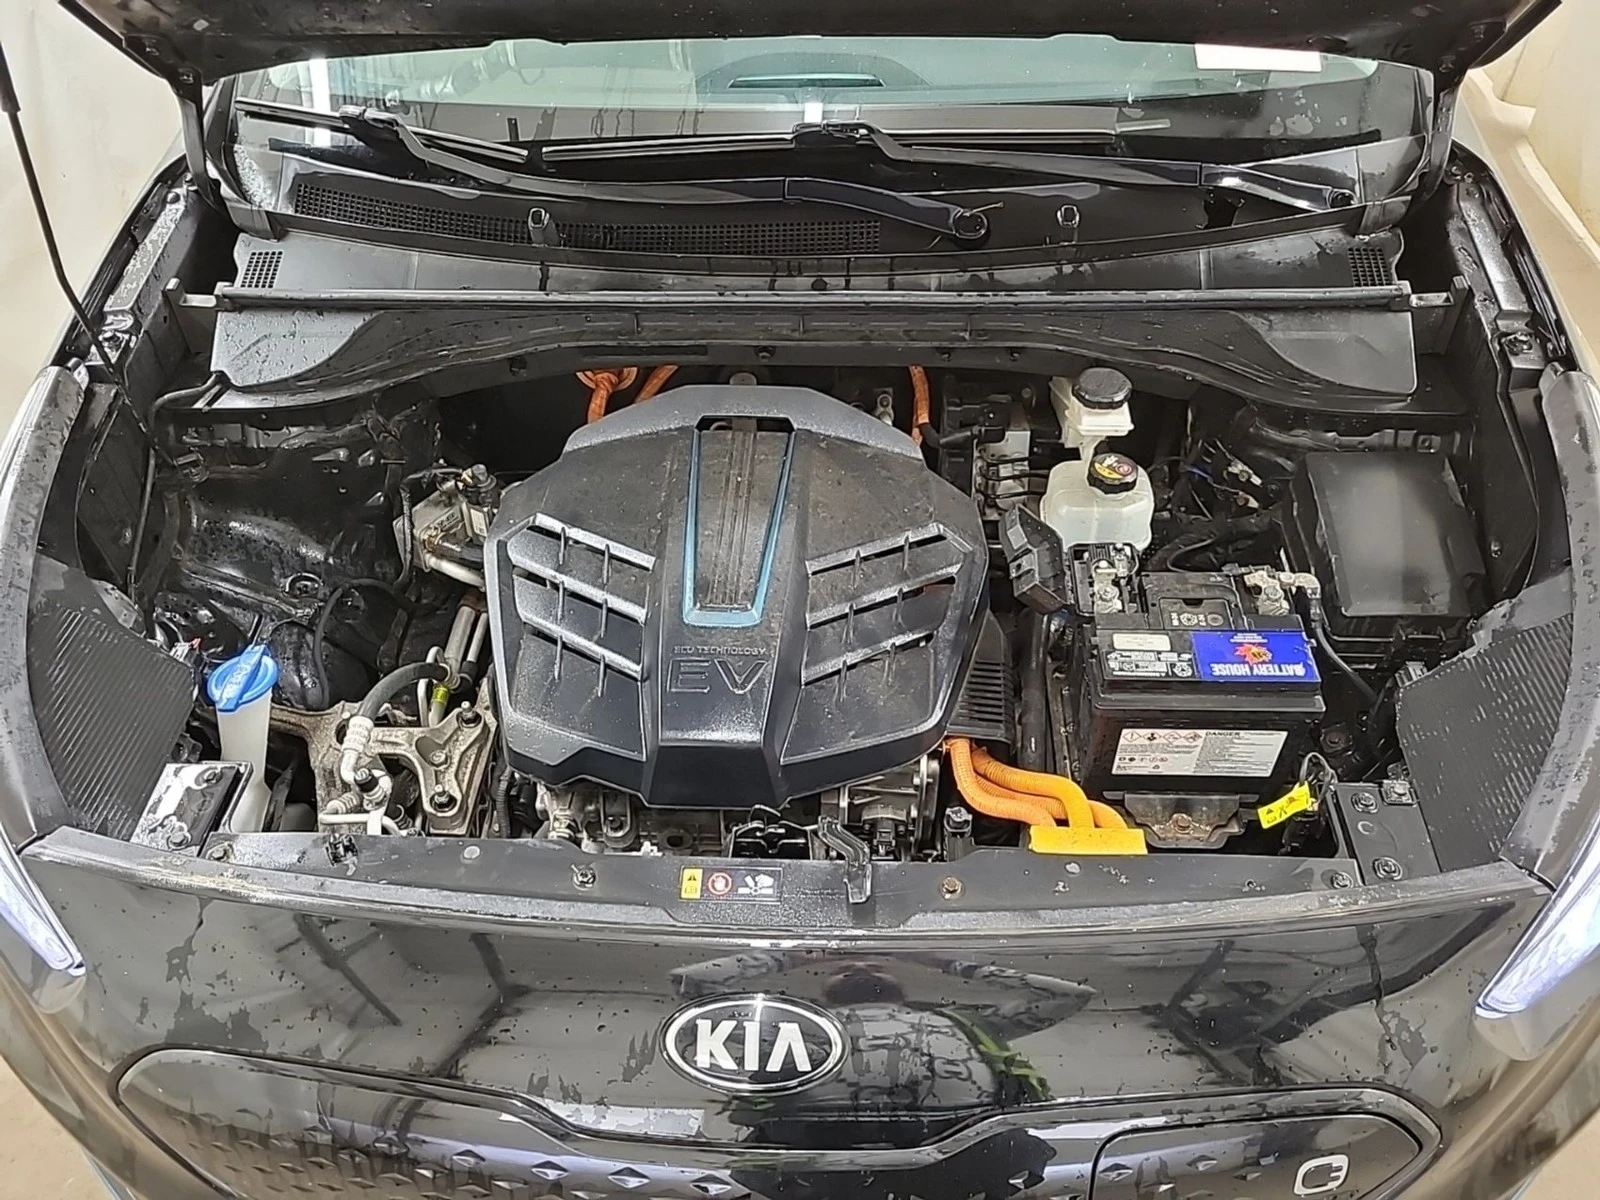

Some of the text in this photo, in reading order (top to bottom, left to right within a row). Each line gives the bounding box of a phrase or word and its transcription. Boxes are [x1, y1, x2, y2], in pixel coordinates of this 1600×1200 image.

[674, 646, 767, 656] ECO TECHNOLOGY
[667, 657, 768, 694] EV
[1211, 662, 1305, 677] BATTERY HOUSE
[696, 1019, 813, 1072] KIA
